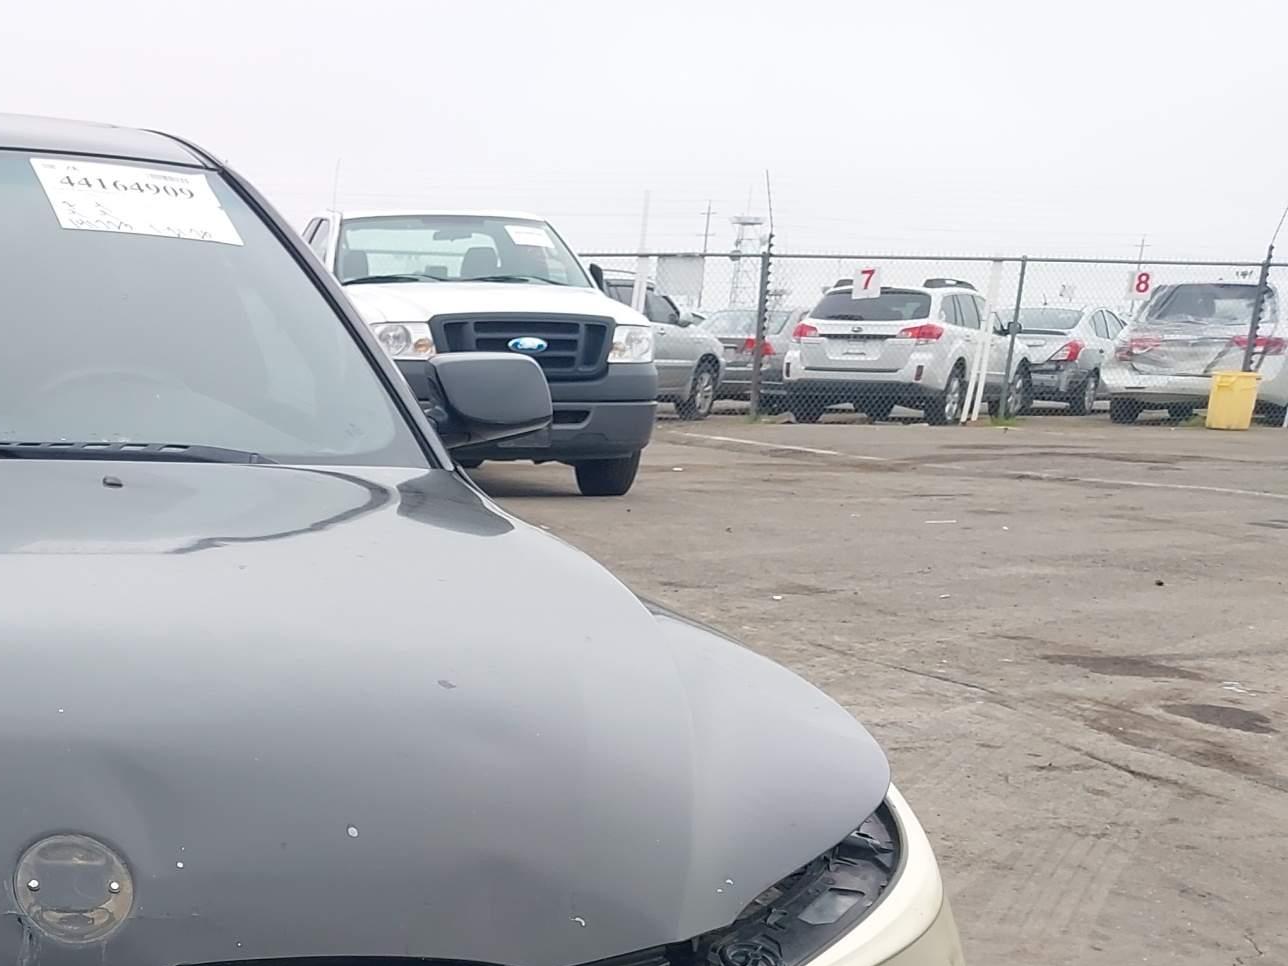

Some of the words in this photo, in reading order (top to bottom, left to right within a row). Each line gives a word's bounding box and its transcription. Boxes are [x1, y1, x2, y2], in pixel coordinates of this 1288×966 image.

[59, 174, 195, 200] 44164909
[860, 268, 876, 290] 7
[1135, 272, 1150, 293] 8
